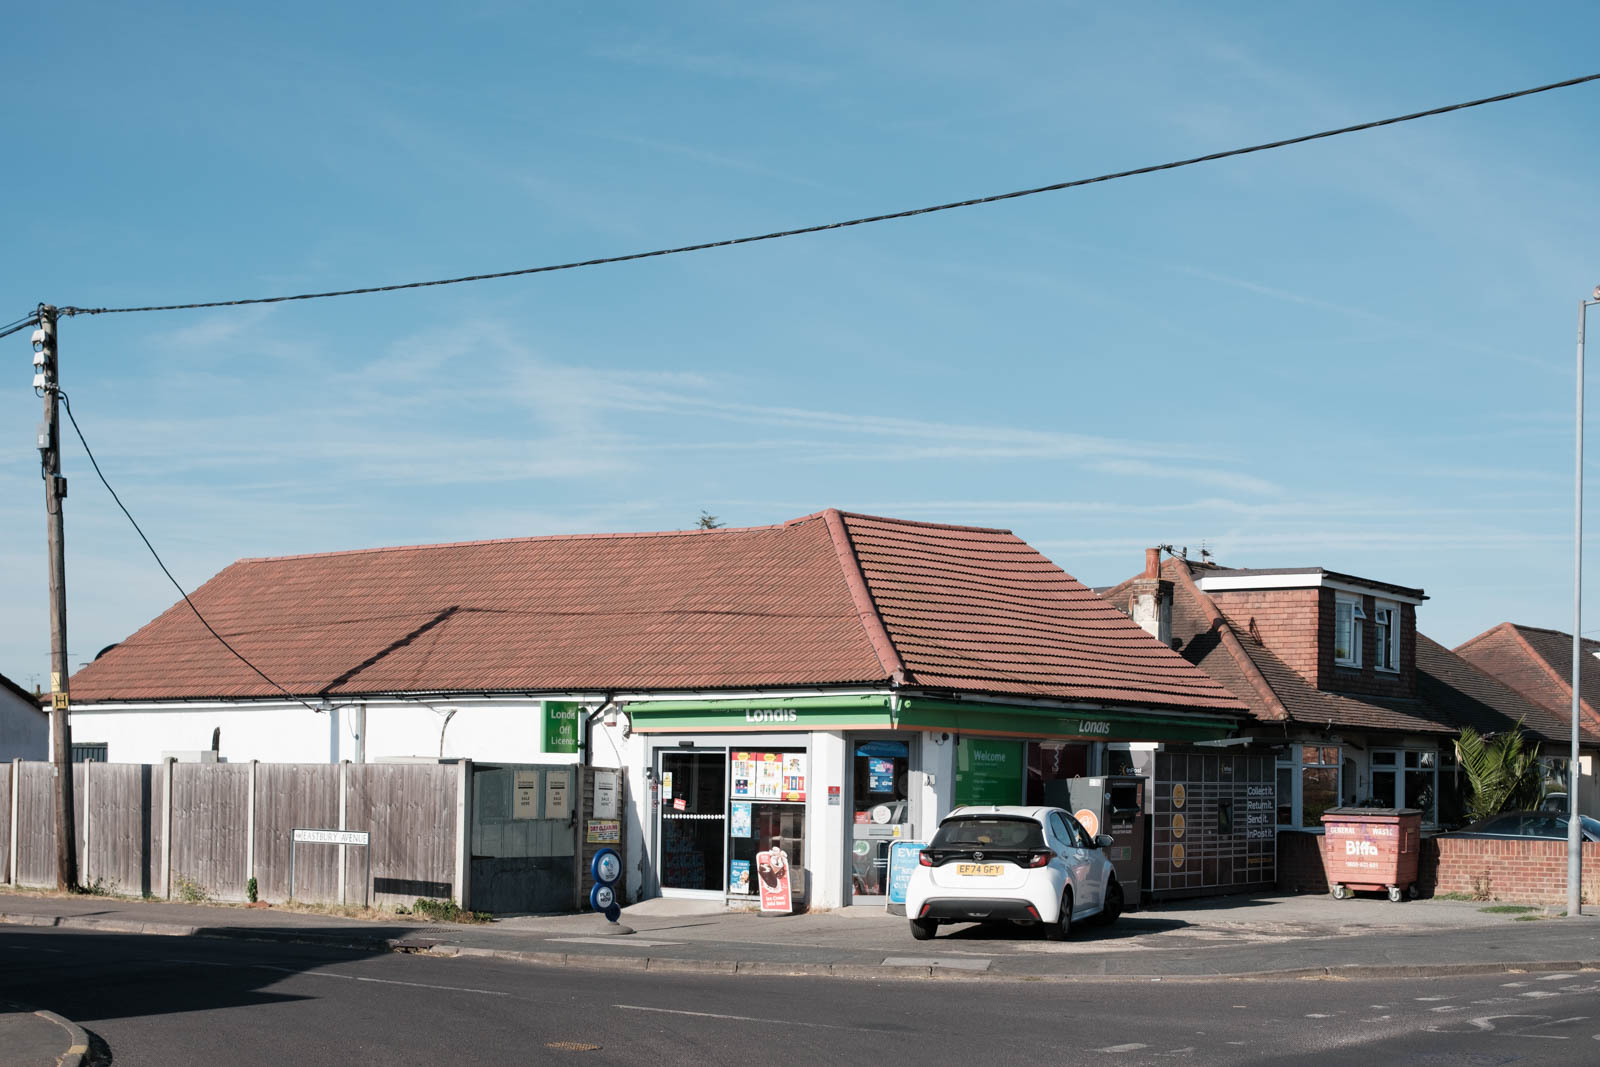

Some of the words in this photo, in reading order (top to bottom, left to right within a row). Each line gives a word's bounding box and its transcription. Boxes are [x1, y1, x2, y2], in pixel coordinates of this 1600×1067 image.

[55, 694, 67, 707] H
[551, 709, 576, 720] Londis
[746, 708, 797, 722] Londis
[559, 725, 571, 735] Off
[1079, 719, 1111, 734] Londis
[551, 736, 576, 745] Licence
[974, 750, 1006, 762] Welcome
[1248, 786, 1267, 796] Collect
[1248, 800, 1268, 810] Return
[1248, 815, 1262, 824] Send
[303, 831, 338, 842] EASTBURY
[341, 833, 368, 843] AVENUE
[1248, 829, 1268, 838] InPost
[1372, 828, 1393, 836] WASTE
[1345, 840, 1378, 856] Biffa
[959, 865, 981, 873] EF74
[983, 865, 1000, 874] GFY
